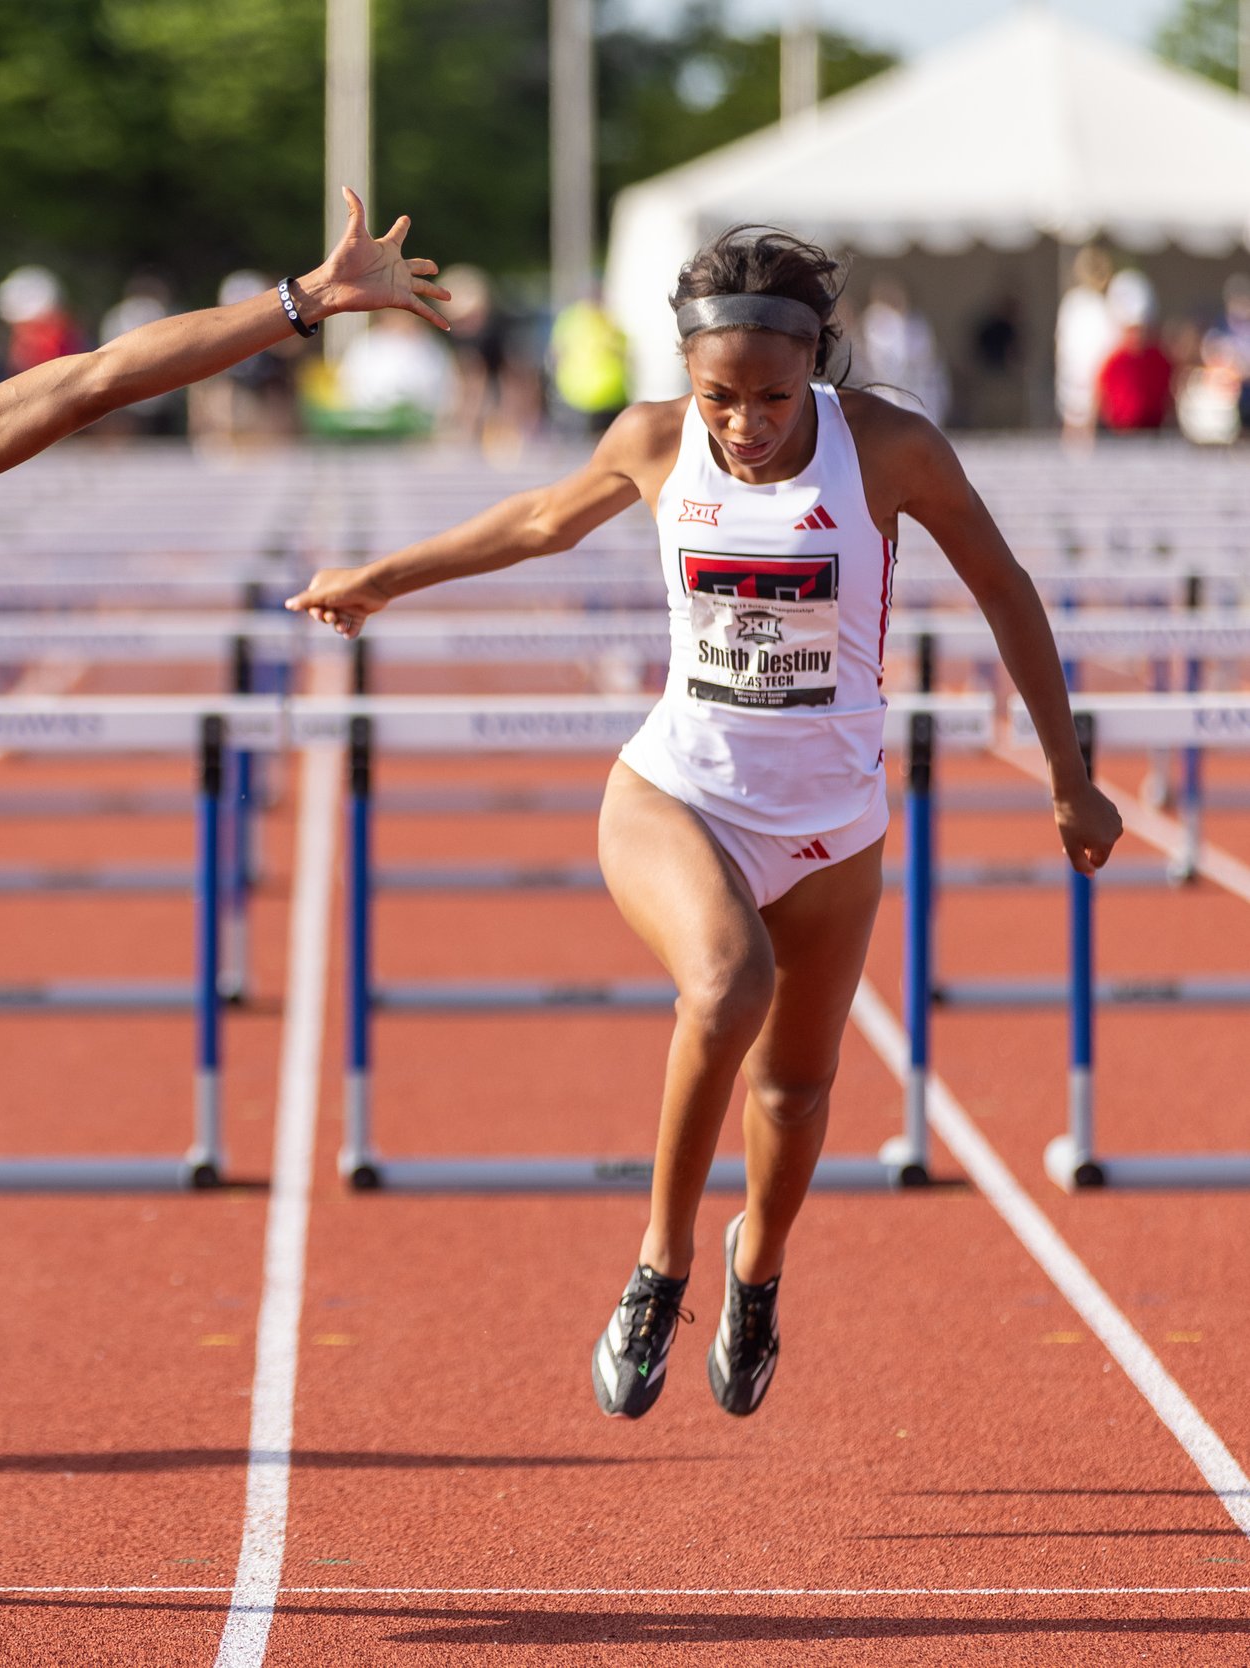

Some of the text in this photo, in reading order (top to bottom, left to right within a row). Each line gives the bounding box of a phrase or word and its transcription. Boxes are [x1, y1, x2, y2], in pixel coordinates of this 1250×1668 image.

[698, 640, 749, 672] Smith
[757, 648, 832, 674] Destiny
[730, 673, 794, 689] TEXAS TECH
